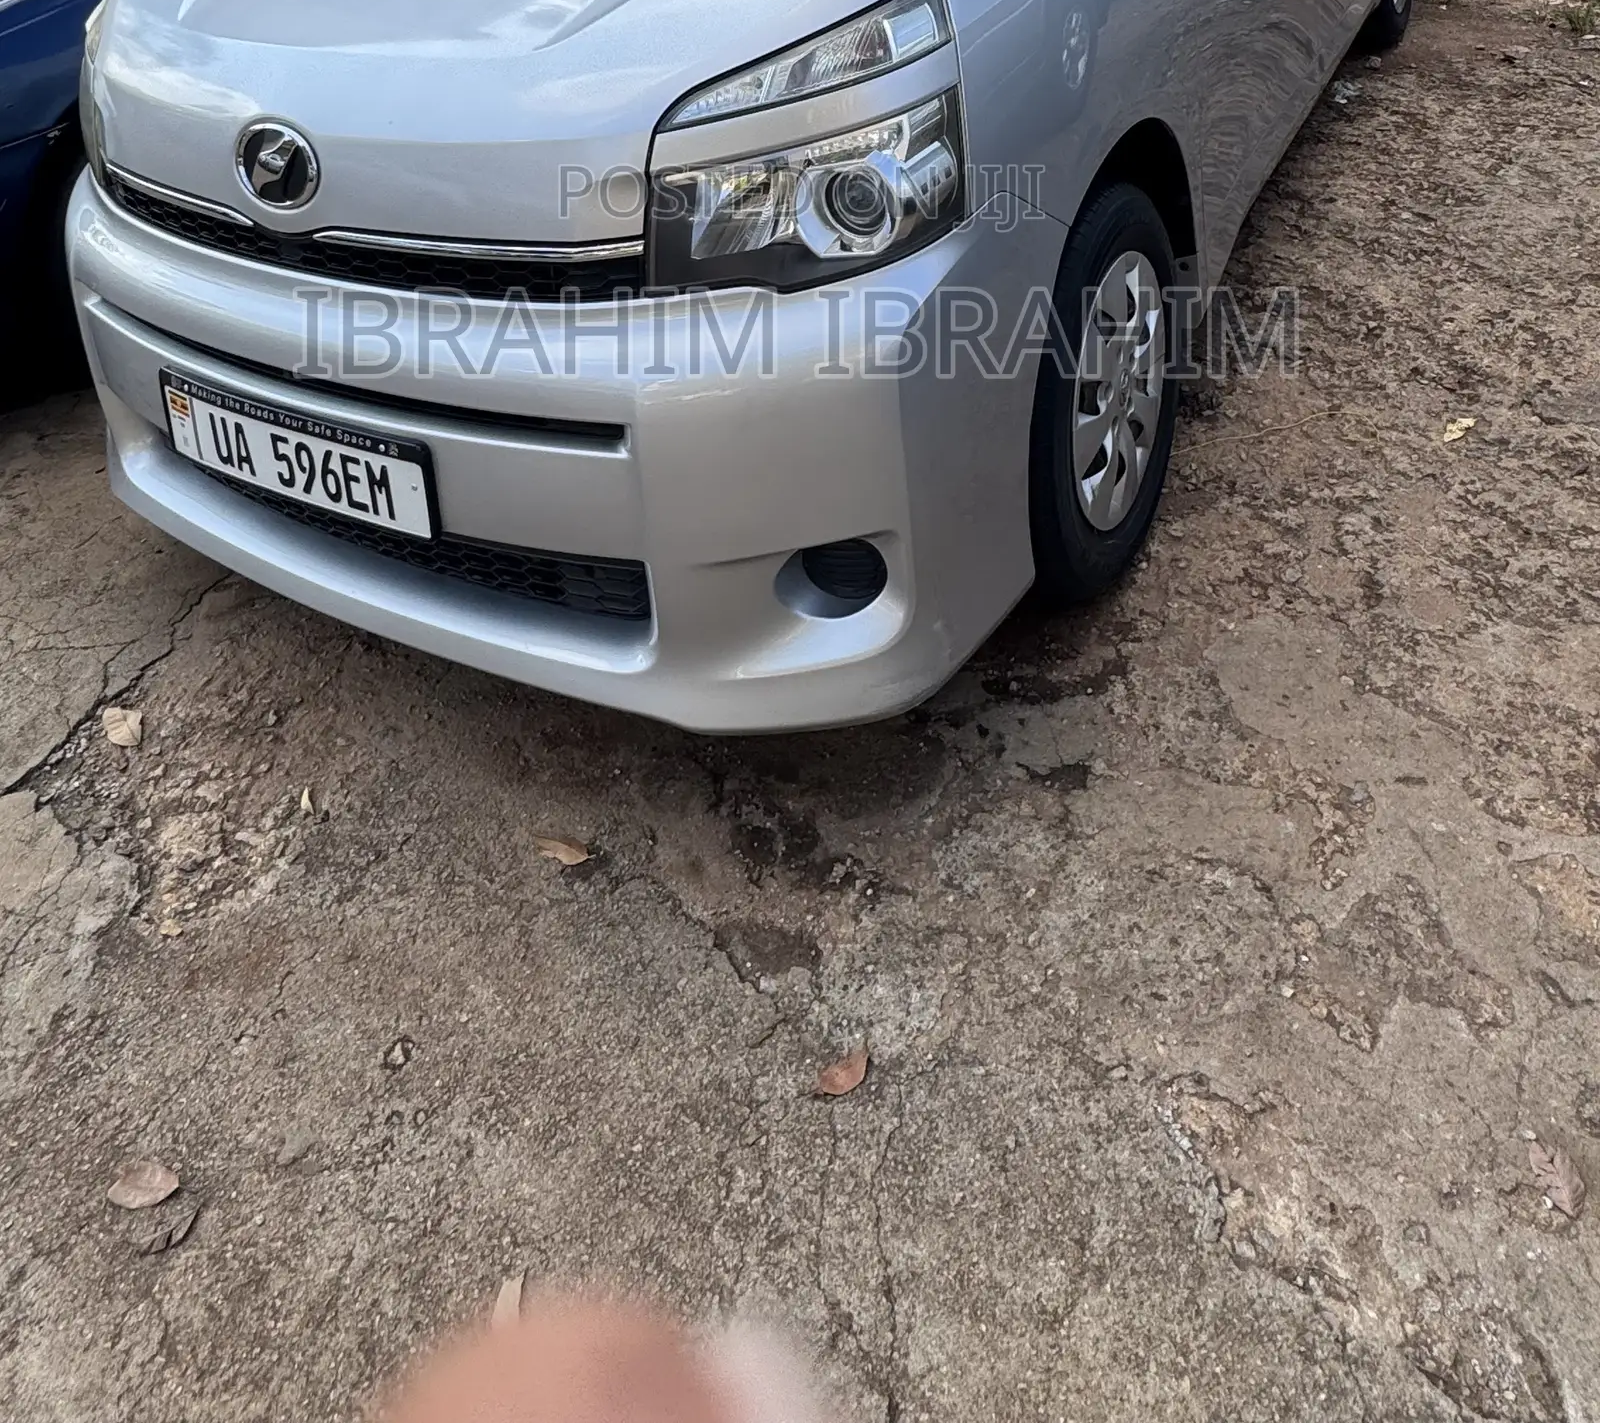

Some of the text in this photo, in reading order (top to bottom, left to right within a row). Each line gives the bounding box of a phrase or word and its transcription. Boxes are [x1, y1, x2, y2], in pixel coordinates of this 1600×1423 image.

[191, 384, 372, 448] Making the Roads Your Safe Space
[208, 411, 397, 521] UA 596EM
